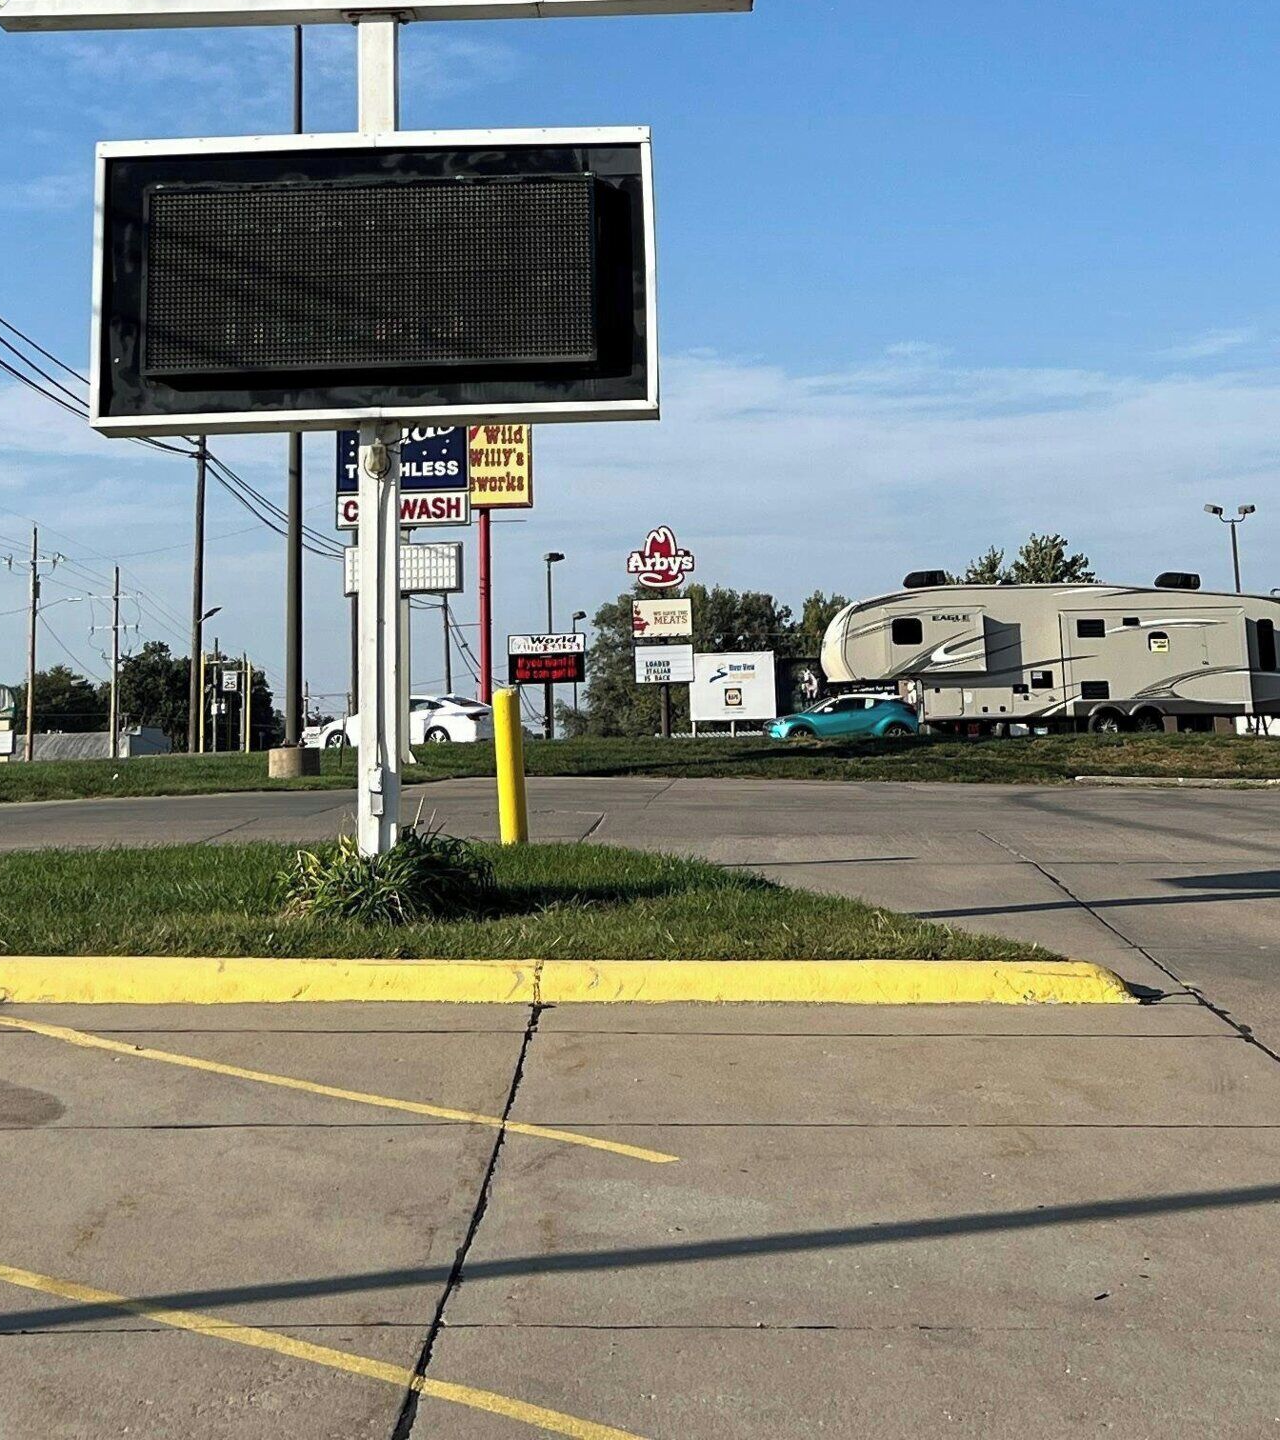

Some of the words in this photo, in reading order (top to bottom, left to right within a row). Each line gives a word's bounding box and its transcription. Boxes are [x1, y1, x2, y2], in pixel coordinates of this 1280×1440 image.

[484, 426, 524, 444] Wild
[470, 448, 524, 467] Willy's
[345, 460, 459, 479] THLESS
[400, 497, 461, 520] WASH
[629, 549, 693, 576] Arby's
[654, 615, 688, 625] MEATS
[530, 636, 577, 645] World
[224, 681, 236, 689] 25
